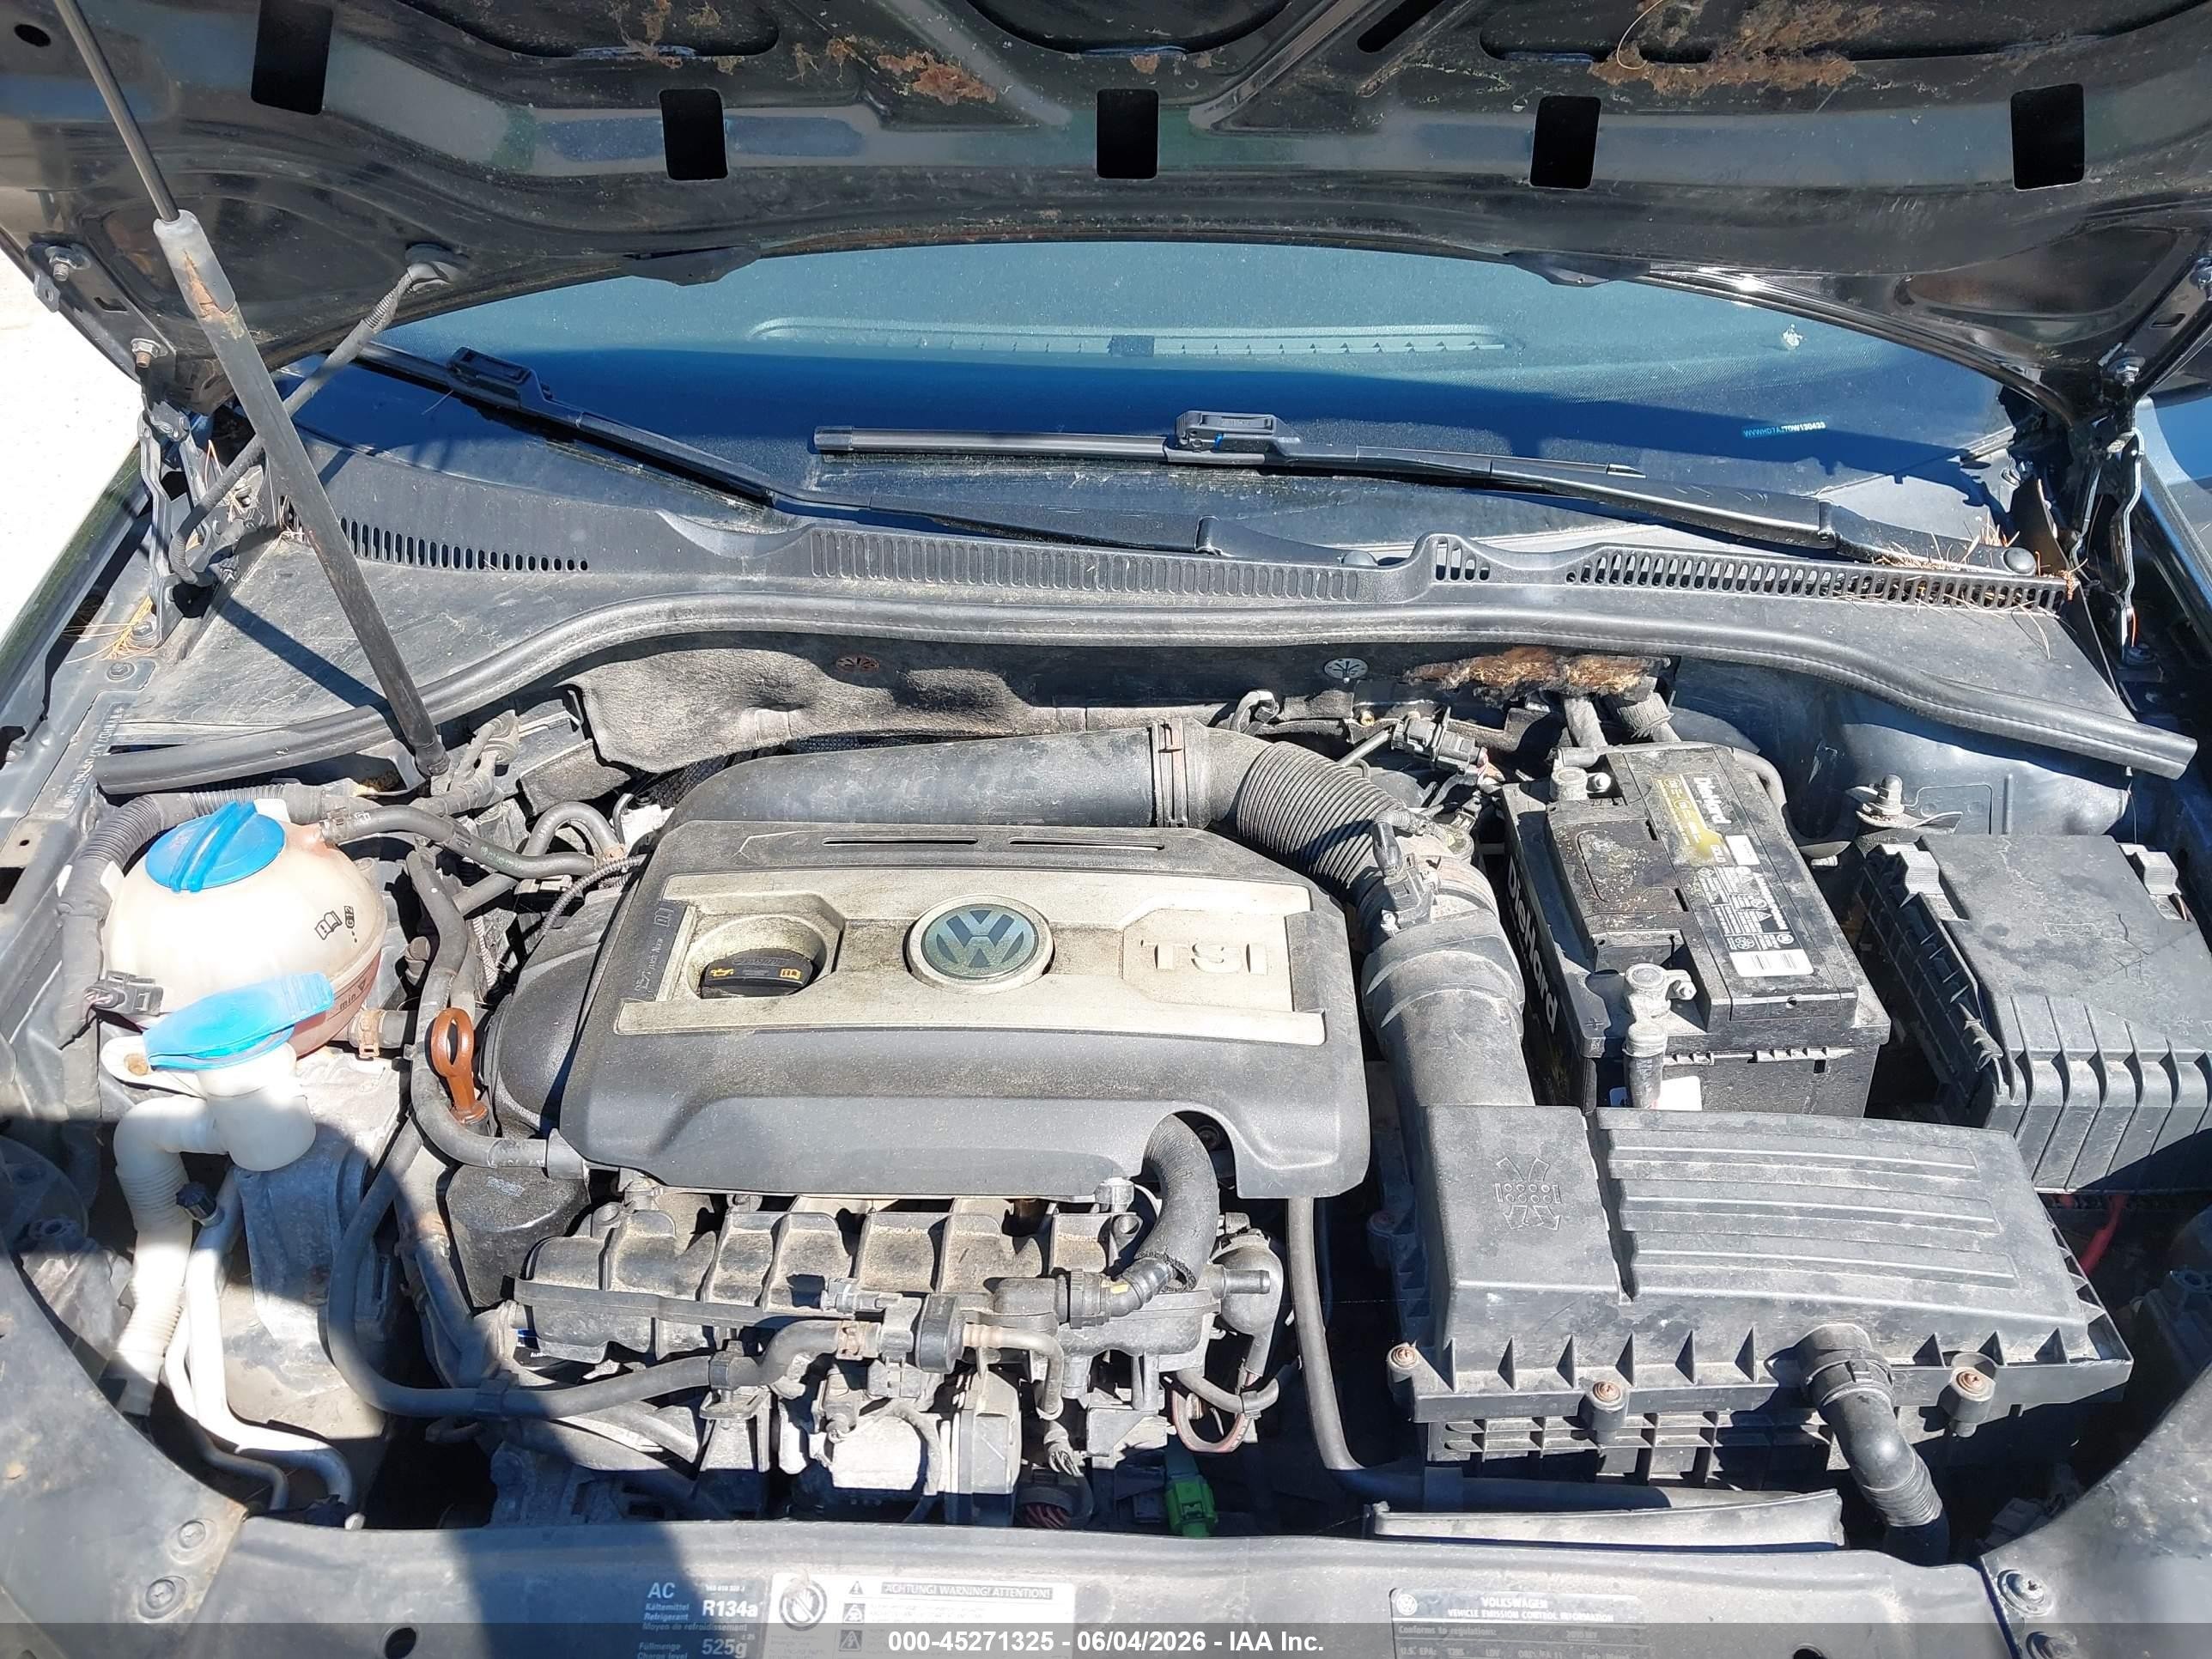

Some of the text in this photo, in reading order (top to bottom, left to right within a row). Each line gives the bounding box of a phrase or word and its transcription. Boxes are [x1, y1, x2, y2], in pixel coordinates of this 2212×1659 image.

[1693, 776, 1732, 824] DieHard
[1508, 855, 1559, 1035] DieHard
[1139, 939, 1269, 976] TSI
[340, 994, 356, 1010] min
[647, 1583, 676, 1599] AC
[885, 1584, 1050, 1599] ACHTUNG! WARNING! ATTENTION!
[645, 1602, 690, 1611] Kältemittel
[702, 1600, 758, 1618] R134a
[1480, 1596, 1548, 1609] VOLKSWAGEN
[644, 1613, 689, 1622] Refrigerant
[1448, 1608, 1614, 1622] VEHICLE EMISSION CONTROL INFORMATION
[642, 1623, 670, 1632] Moyen
[684, 1623, 747, 1632] refroidissement
[1399, 1626, 1436, 1635] Conforms
[1438, 1626, 1448, 1635] to
[701, 1638, 748, 1659] 525g
